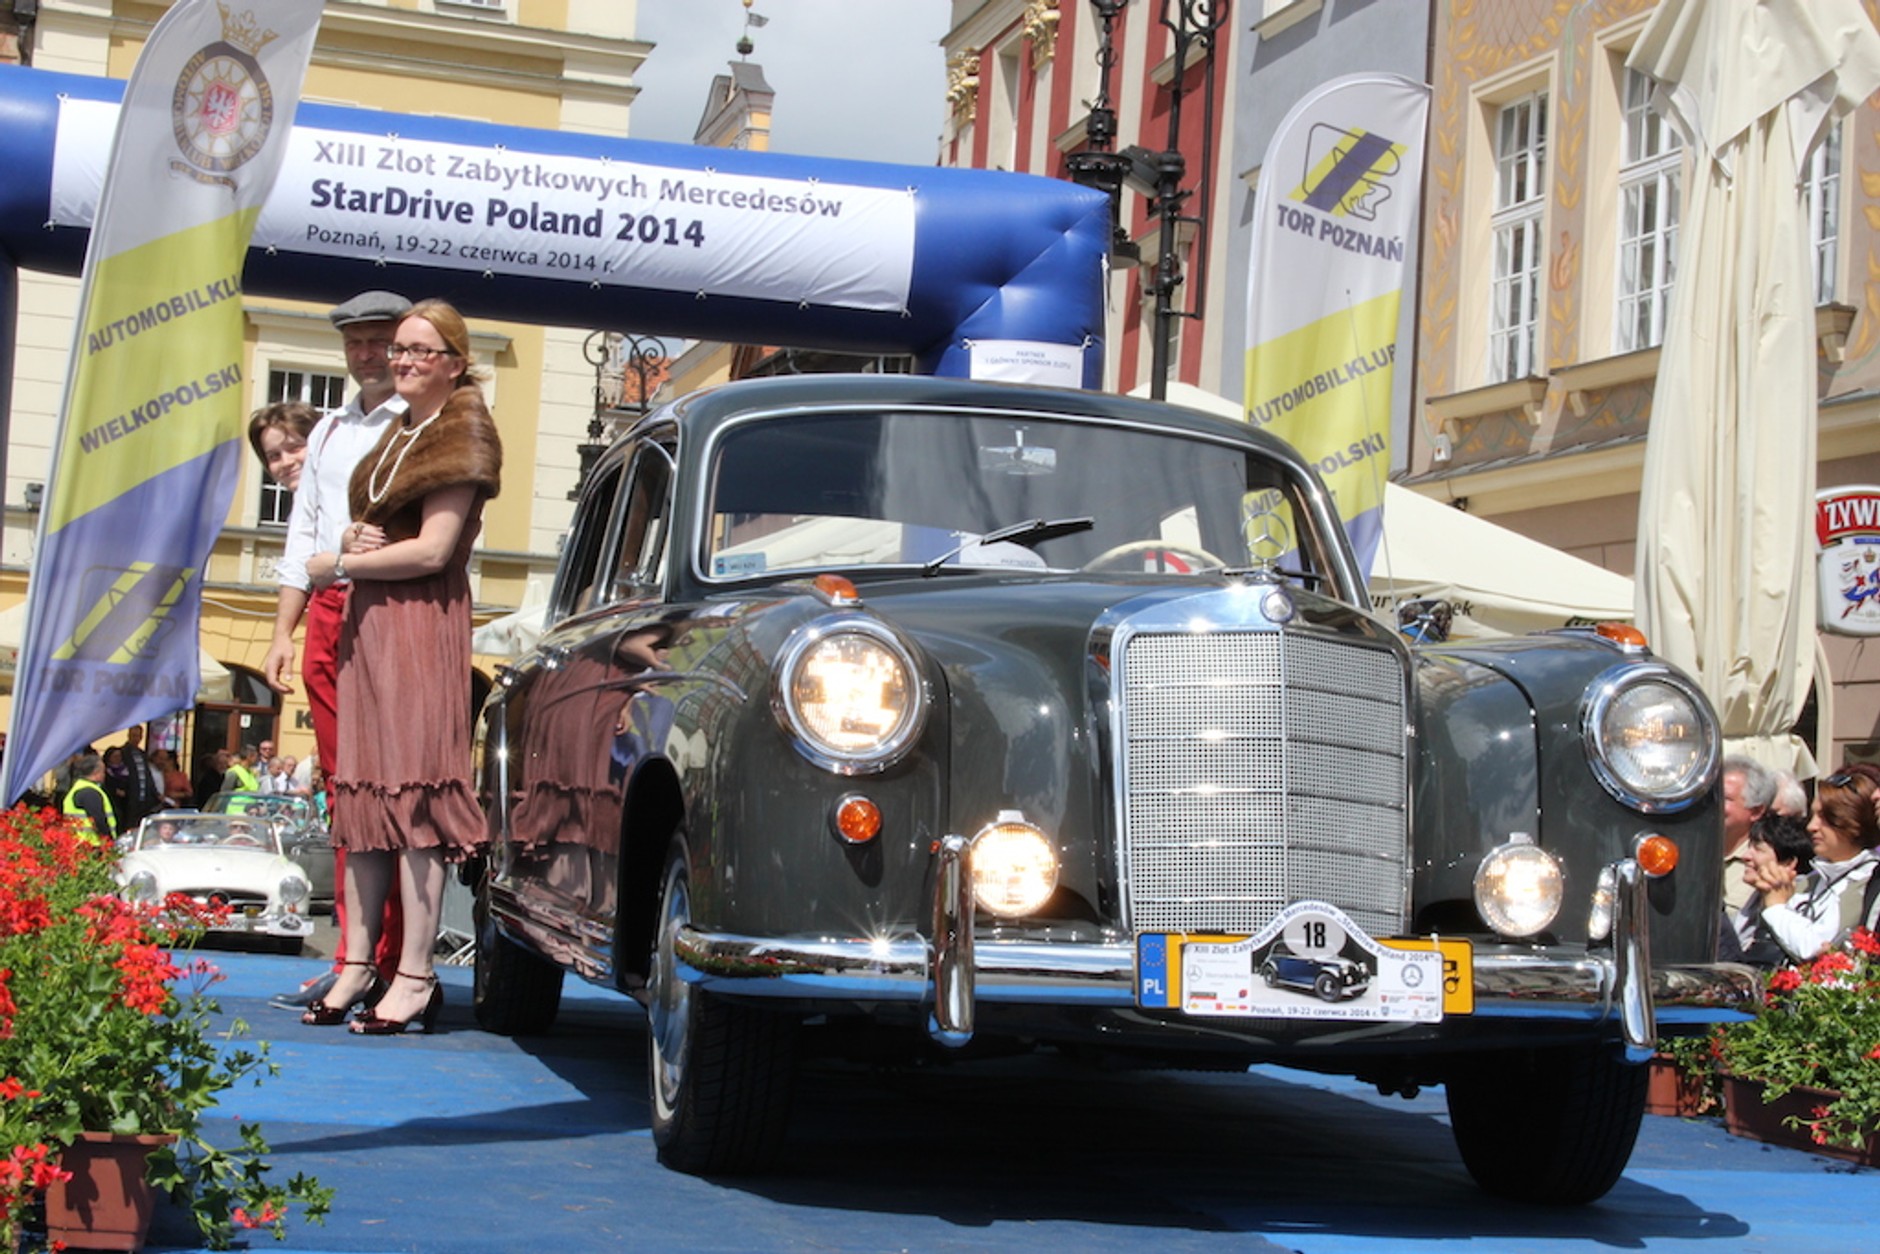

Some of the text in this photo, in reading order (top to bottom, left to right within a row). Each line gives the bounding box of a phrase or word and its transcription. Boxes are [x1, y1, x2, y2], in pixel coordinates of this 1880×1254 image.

[314, 140, 842, 217] XIII Zlot Zabytkowych Mercedesów
[310, 178, 705, 248] StarDrive Poland 2014
[306, 224, 614, 274] Poznań, 19-22 czerwca 2014 r.
[1277, 204, 1403, 262] TOR POZNAŃ
[79, 363, 243, 454] WIELKOPOLSKI
[40, 668, 85, 693] TOR
[1194, 946, 1209, 954] XIII
[1211, 946, 1229, 954] Zlot
[1376, 945, 1406, 961] Poland
[1303, 921, 1326, 949] 18
[1143, 978, 1164, 995] PL
[1287, 1006, 1311, 1015] 19-22
[1313, 1008, 1347, 1017] czerwca
[1349, 1008, 1370, 1017] 2014
